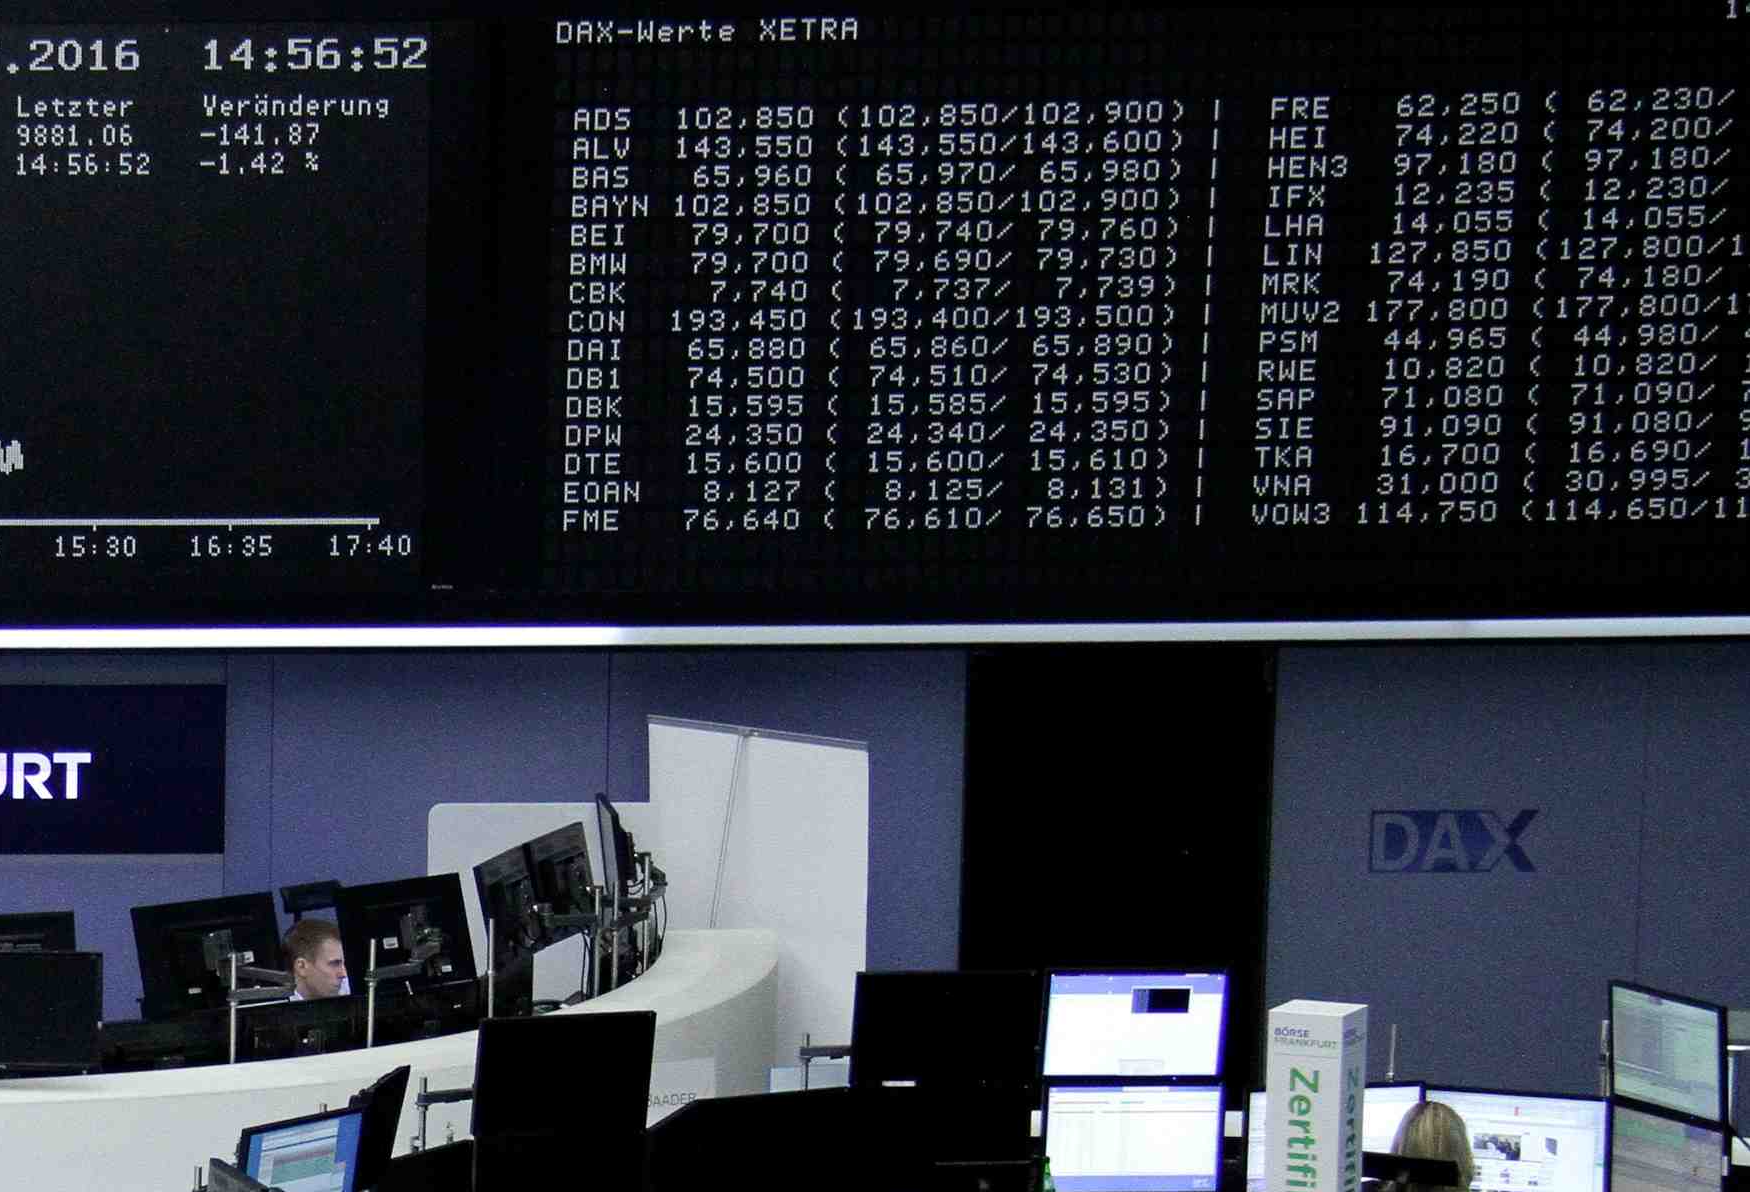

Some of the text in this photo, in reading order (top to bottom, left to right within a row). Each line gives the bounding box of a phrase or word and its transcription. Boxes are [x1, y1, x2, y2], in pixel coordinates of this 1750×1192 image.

[556, 17, 858, 44] DAX-Werte XETRA
[204, 37, 428, 73] 14:56:52
[17, 95, 134, 118] Letzter
[203, 93, 389, 119] Veränderung
[573, 107, 631, 131] ADS
[677, 105, 814, 130] 102,850
[1270, 91, 1520, 121] FRE 62,250
[16, 123, 133, 147] 9881.06
[199, 122, 320, 146] -141.87
[572, 136, 630, 160] ALV
[676, 135, 813, 159] 143,550
[1269, 121, 1519, 150] HEI 74,220
[16, 151, 150, 176] 14:56:52
[199, 151, 285, 175] -1.42
[305, 151, 319, 171] %
[572, 164, 812, 189] BAS 65,960
[1267, 150, 1517, 179] HEN3 97,180
[571, 194, 649, 218] BAYN
[674, 193, 811, 217] 102,850
[1268, 180, 1515, 208] IFX 12,235
[570, 222, 810, 247] BEI 79,700
[1264, 209, 1513, 238] LHA 14,055
[569, 250, 809, 276] BMW 79,700
[1263, 239, 1512, 267] LIN 127,850
[569, 279, 808, 305] CBK 7,740
[1261, 268, 1510, 296] MRK 74,190
[568, 309, 625, 333] CON
[671, 308, 806, 332] 193,450
[1260, 297, 1508, 325] MUV2 177,800
[567, 337, 806, 362] DAI 65,880
[1259, 326, 1507, 353] PSM 44,965
[566, 365, 805, 390] DB1 74,500
[1257, 355, 1505, 382] RWE 10,820
[565, 394, 804, 419] DBK 15,595
[1256, 384, 1503, 411] SAP 71,080
[565, 423, 803, 447] DPW 24,350
[1254, 413, 1502, 440] SIE 91,090
[564, 451, 802, 475] DTE 15,600
[1254, 442, 1500, 468] TKA 16,700
[563, 479, 801, 504] EOAN 8,127
[1253, 471, 1499, 497] VNA 31,000
[562, 508, 800, 532] FME 76,640
[1251, 500, 1497, 526] VOW3 114,750
[55, 535, 136, 558] 15:30
[190, 534, 273, 557] 16:35
[329, 534, 411, 557] 17:40
[1370, 809, 1539, 872] DAX
